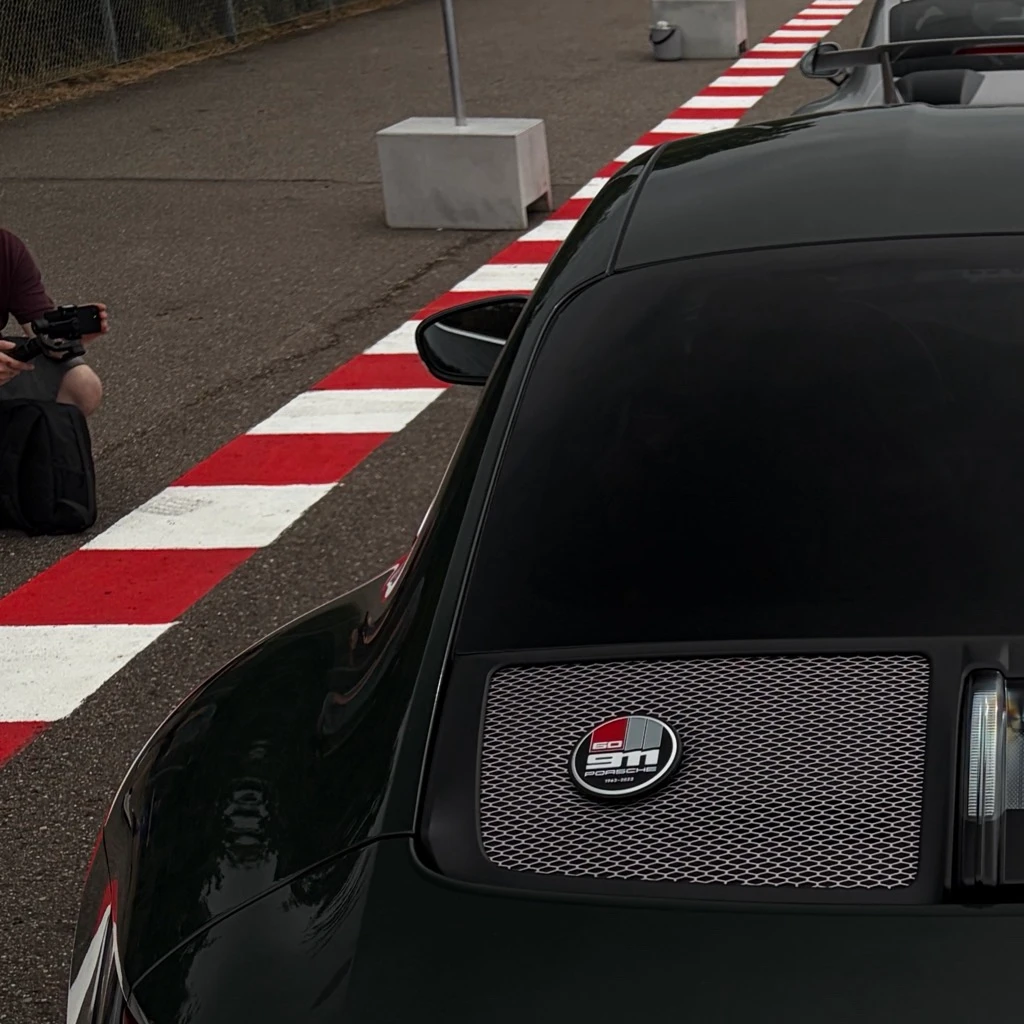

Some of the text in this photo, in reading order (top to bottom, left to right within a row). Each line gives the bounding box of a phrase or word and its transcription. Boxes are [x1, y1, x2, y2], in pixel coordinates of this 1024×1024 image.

[592, 740, 622, 750] 60
[585, 749, 660, 770] 911
[584, 766, 658, 777] PORSCHE
